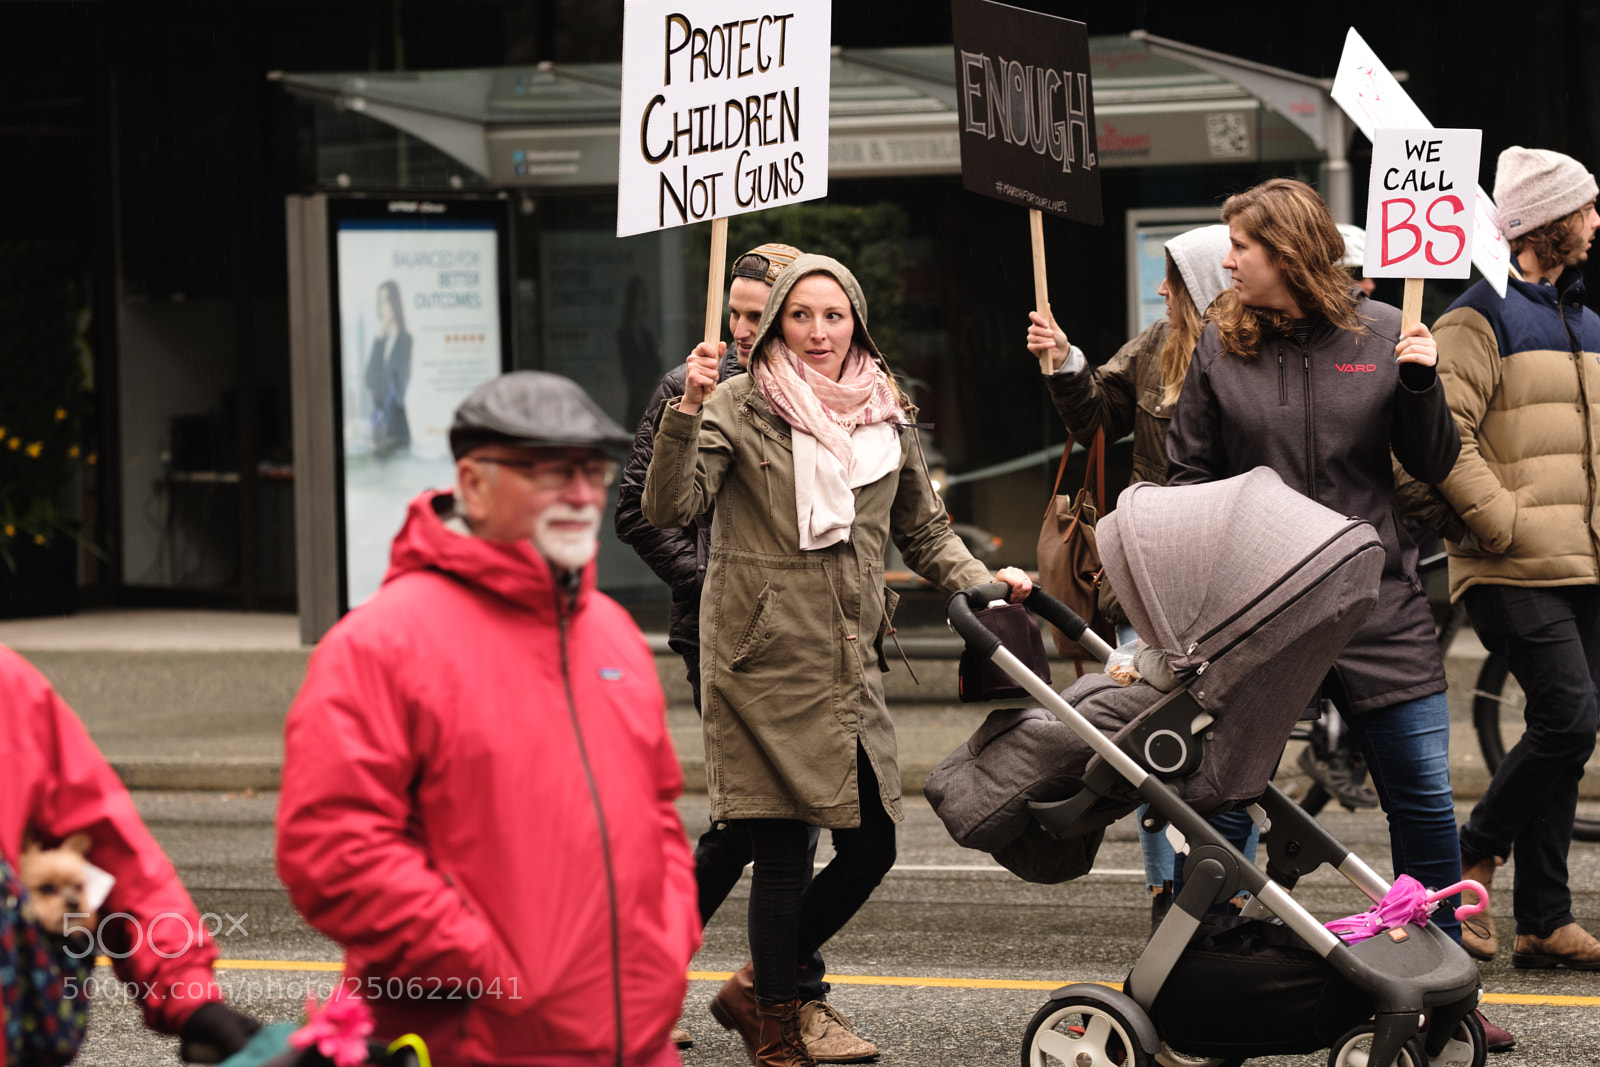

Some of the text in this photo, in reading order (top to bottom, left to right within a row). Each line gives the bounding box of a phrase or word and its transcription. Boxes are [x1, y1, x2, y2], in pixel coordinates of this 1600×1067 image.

[664, 13, 794, 86] PROTECT
[640, 86, 799, 164] CHILDREN
[1405, 139, 1443, 163] WE
[659, 150, 804, 227] NOT GUNS
[1383, 167, 1454, 192] CALL
[1380, 195, 1466, 268] BS
[1334, 363, 1377, 373] VARD
